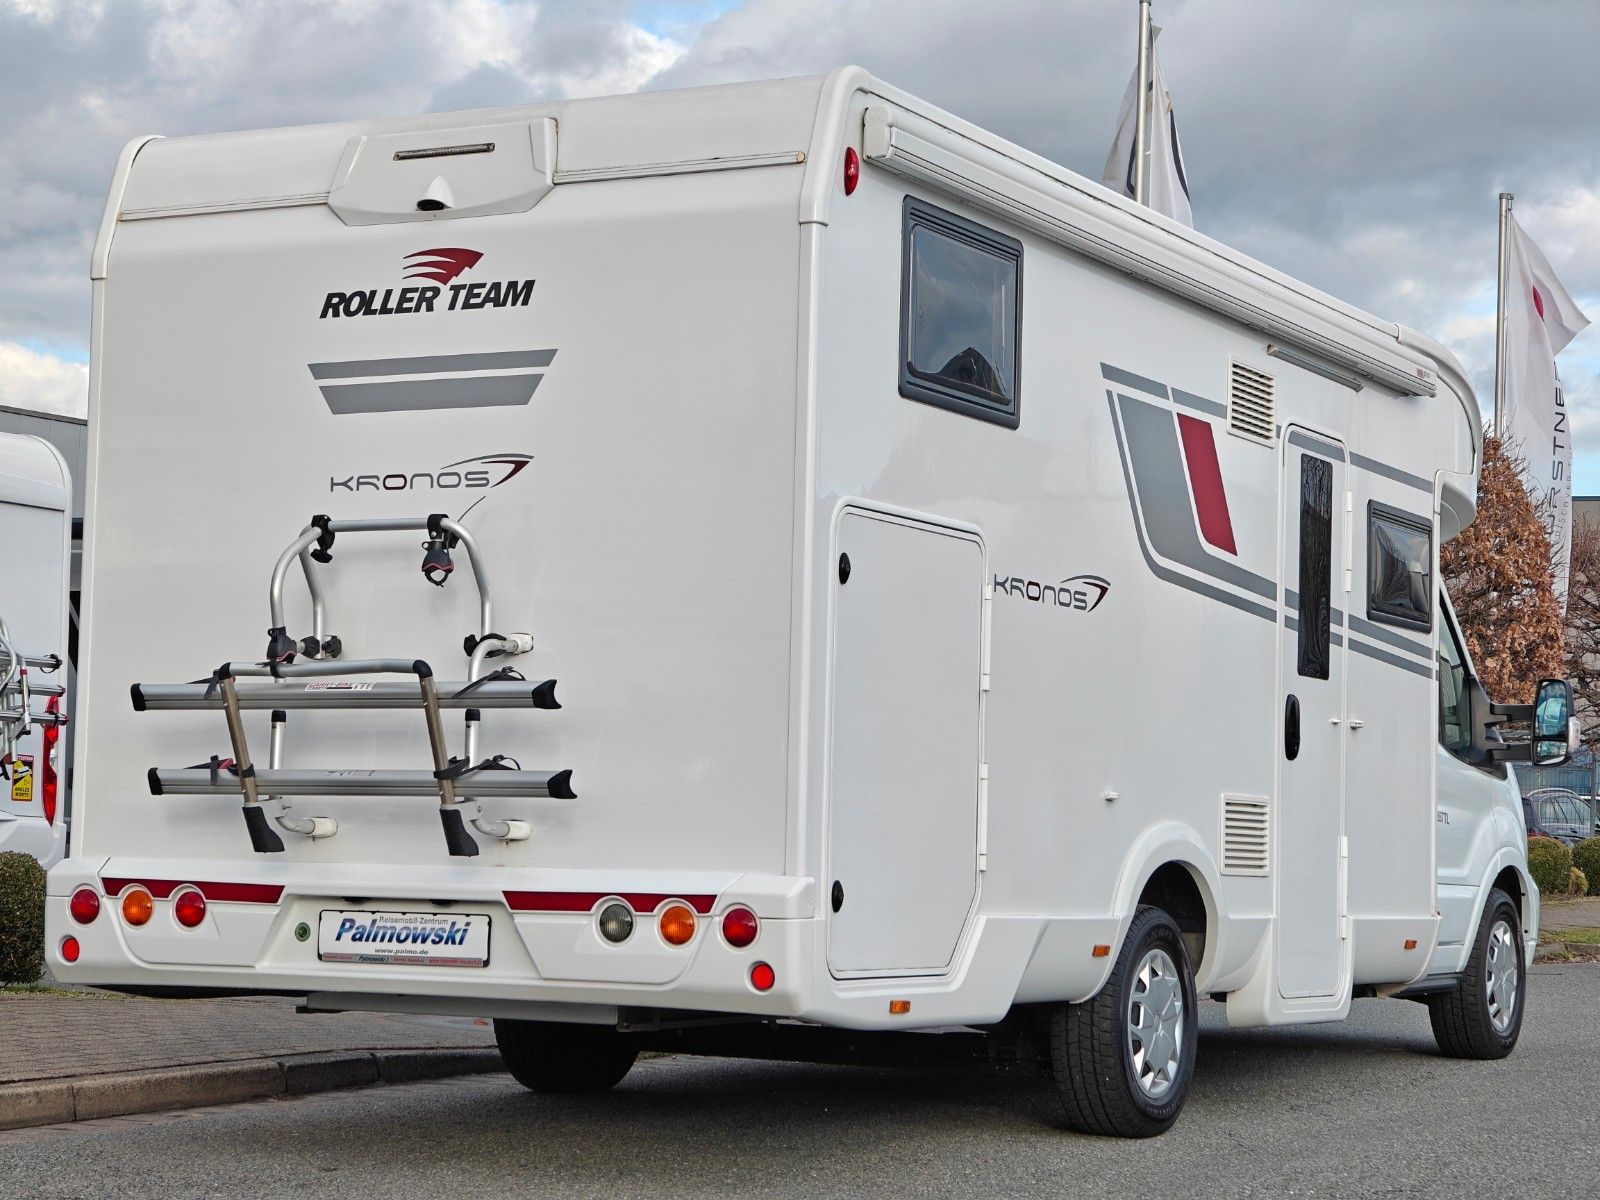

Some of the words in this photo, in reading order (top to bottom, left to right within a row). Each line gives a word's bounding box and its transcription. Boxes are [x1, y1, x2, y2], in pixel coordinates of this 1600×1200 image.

[319, 285, 441, 319] ROLLER
[447, 279, 536, 311] TEAM
[330, 470, 490, 493] KRONOS
[993, 573, 1088, 611] KRONOS
[335, 918, 471, 946] Palmowski
[378, 916, 448, 925] Reisemobil-Zentrum
[374, 948, 429, 956] www.palmo.de
